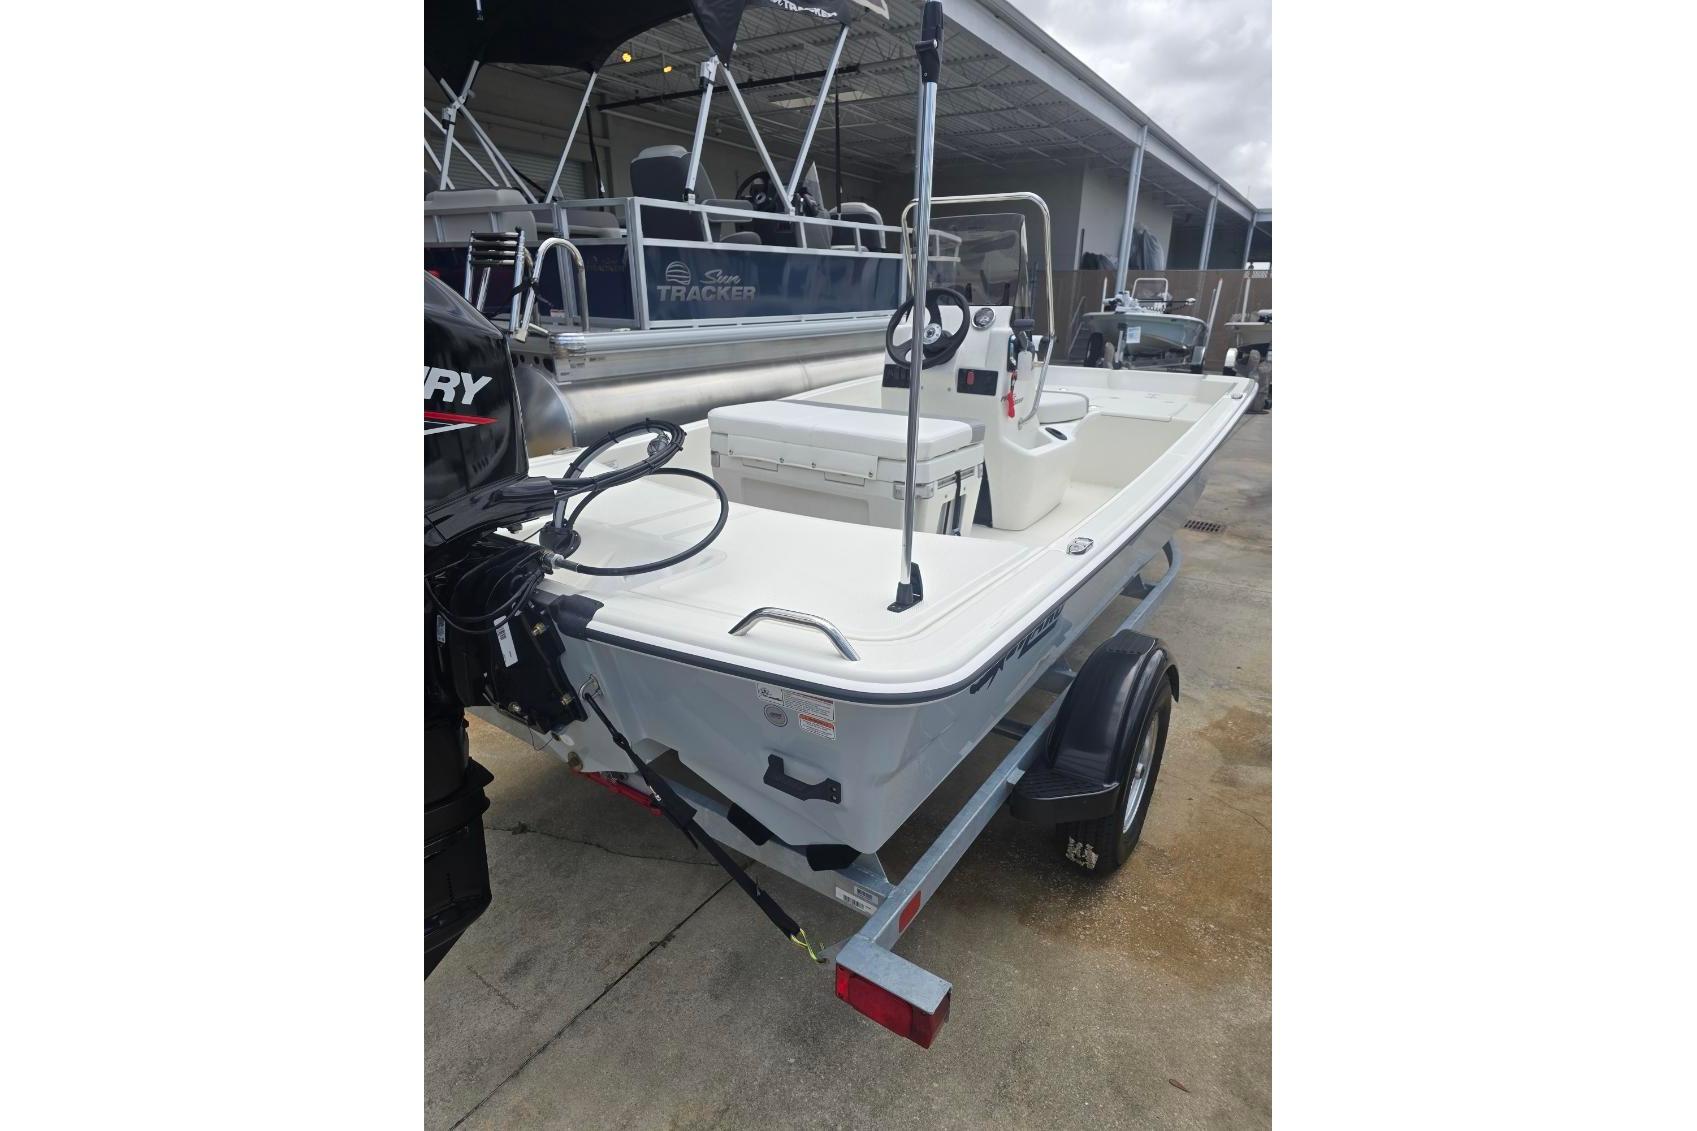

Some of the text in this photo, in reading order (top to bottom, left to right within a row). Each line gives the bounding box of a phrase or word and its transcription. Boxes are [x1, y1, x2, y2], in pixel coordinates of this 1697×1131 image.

[700, 269, 742, 285] Sun
[656, 285, 756, 303] TRACKER
[424, 365, 493, 405] RY
